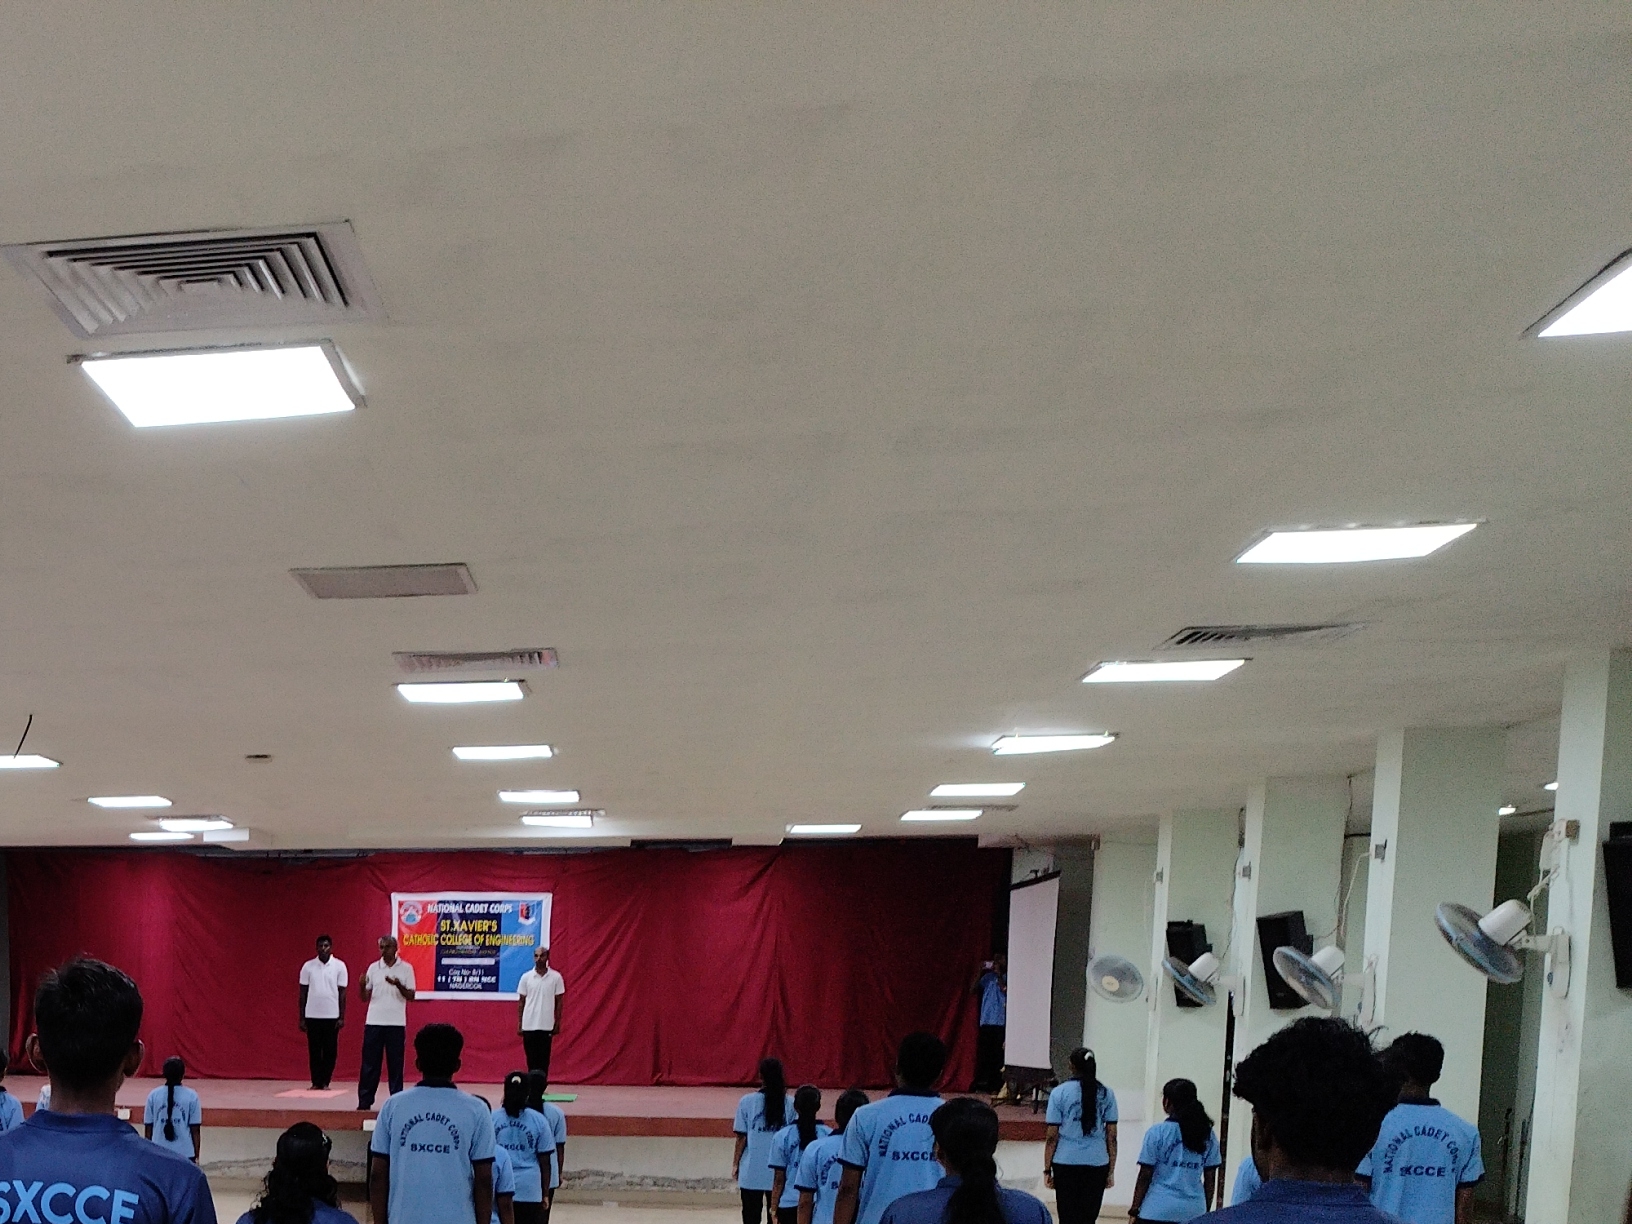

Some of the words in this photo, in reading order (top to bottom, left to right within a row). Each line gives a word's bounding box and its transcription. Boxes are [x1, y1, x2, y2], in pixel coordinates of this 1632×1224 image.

[428, 903, 464, 913] NATIONAL
[465, 903, 487, 913] CADET
[403, 934, 439, 946] CATHOLIC
[440, 934, 473, 946] COLLEGE
[474, 934, 485, 946] OF
[485, 934, 535, 947] ENGINEERING
[425, 1112, 450, 1126] CADET
[908, 1112, 929, 1124] CAD
[1413, 1125, 1450, 1142] CADET
